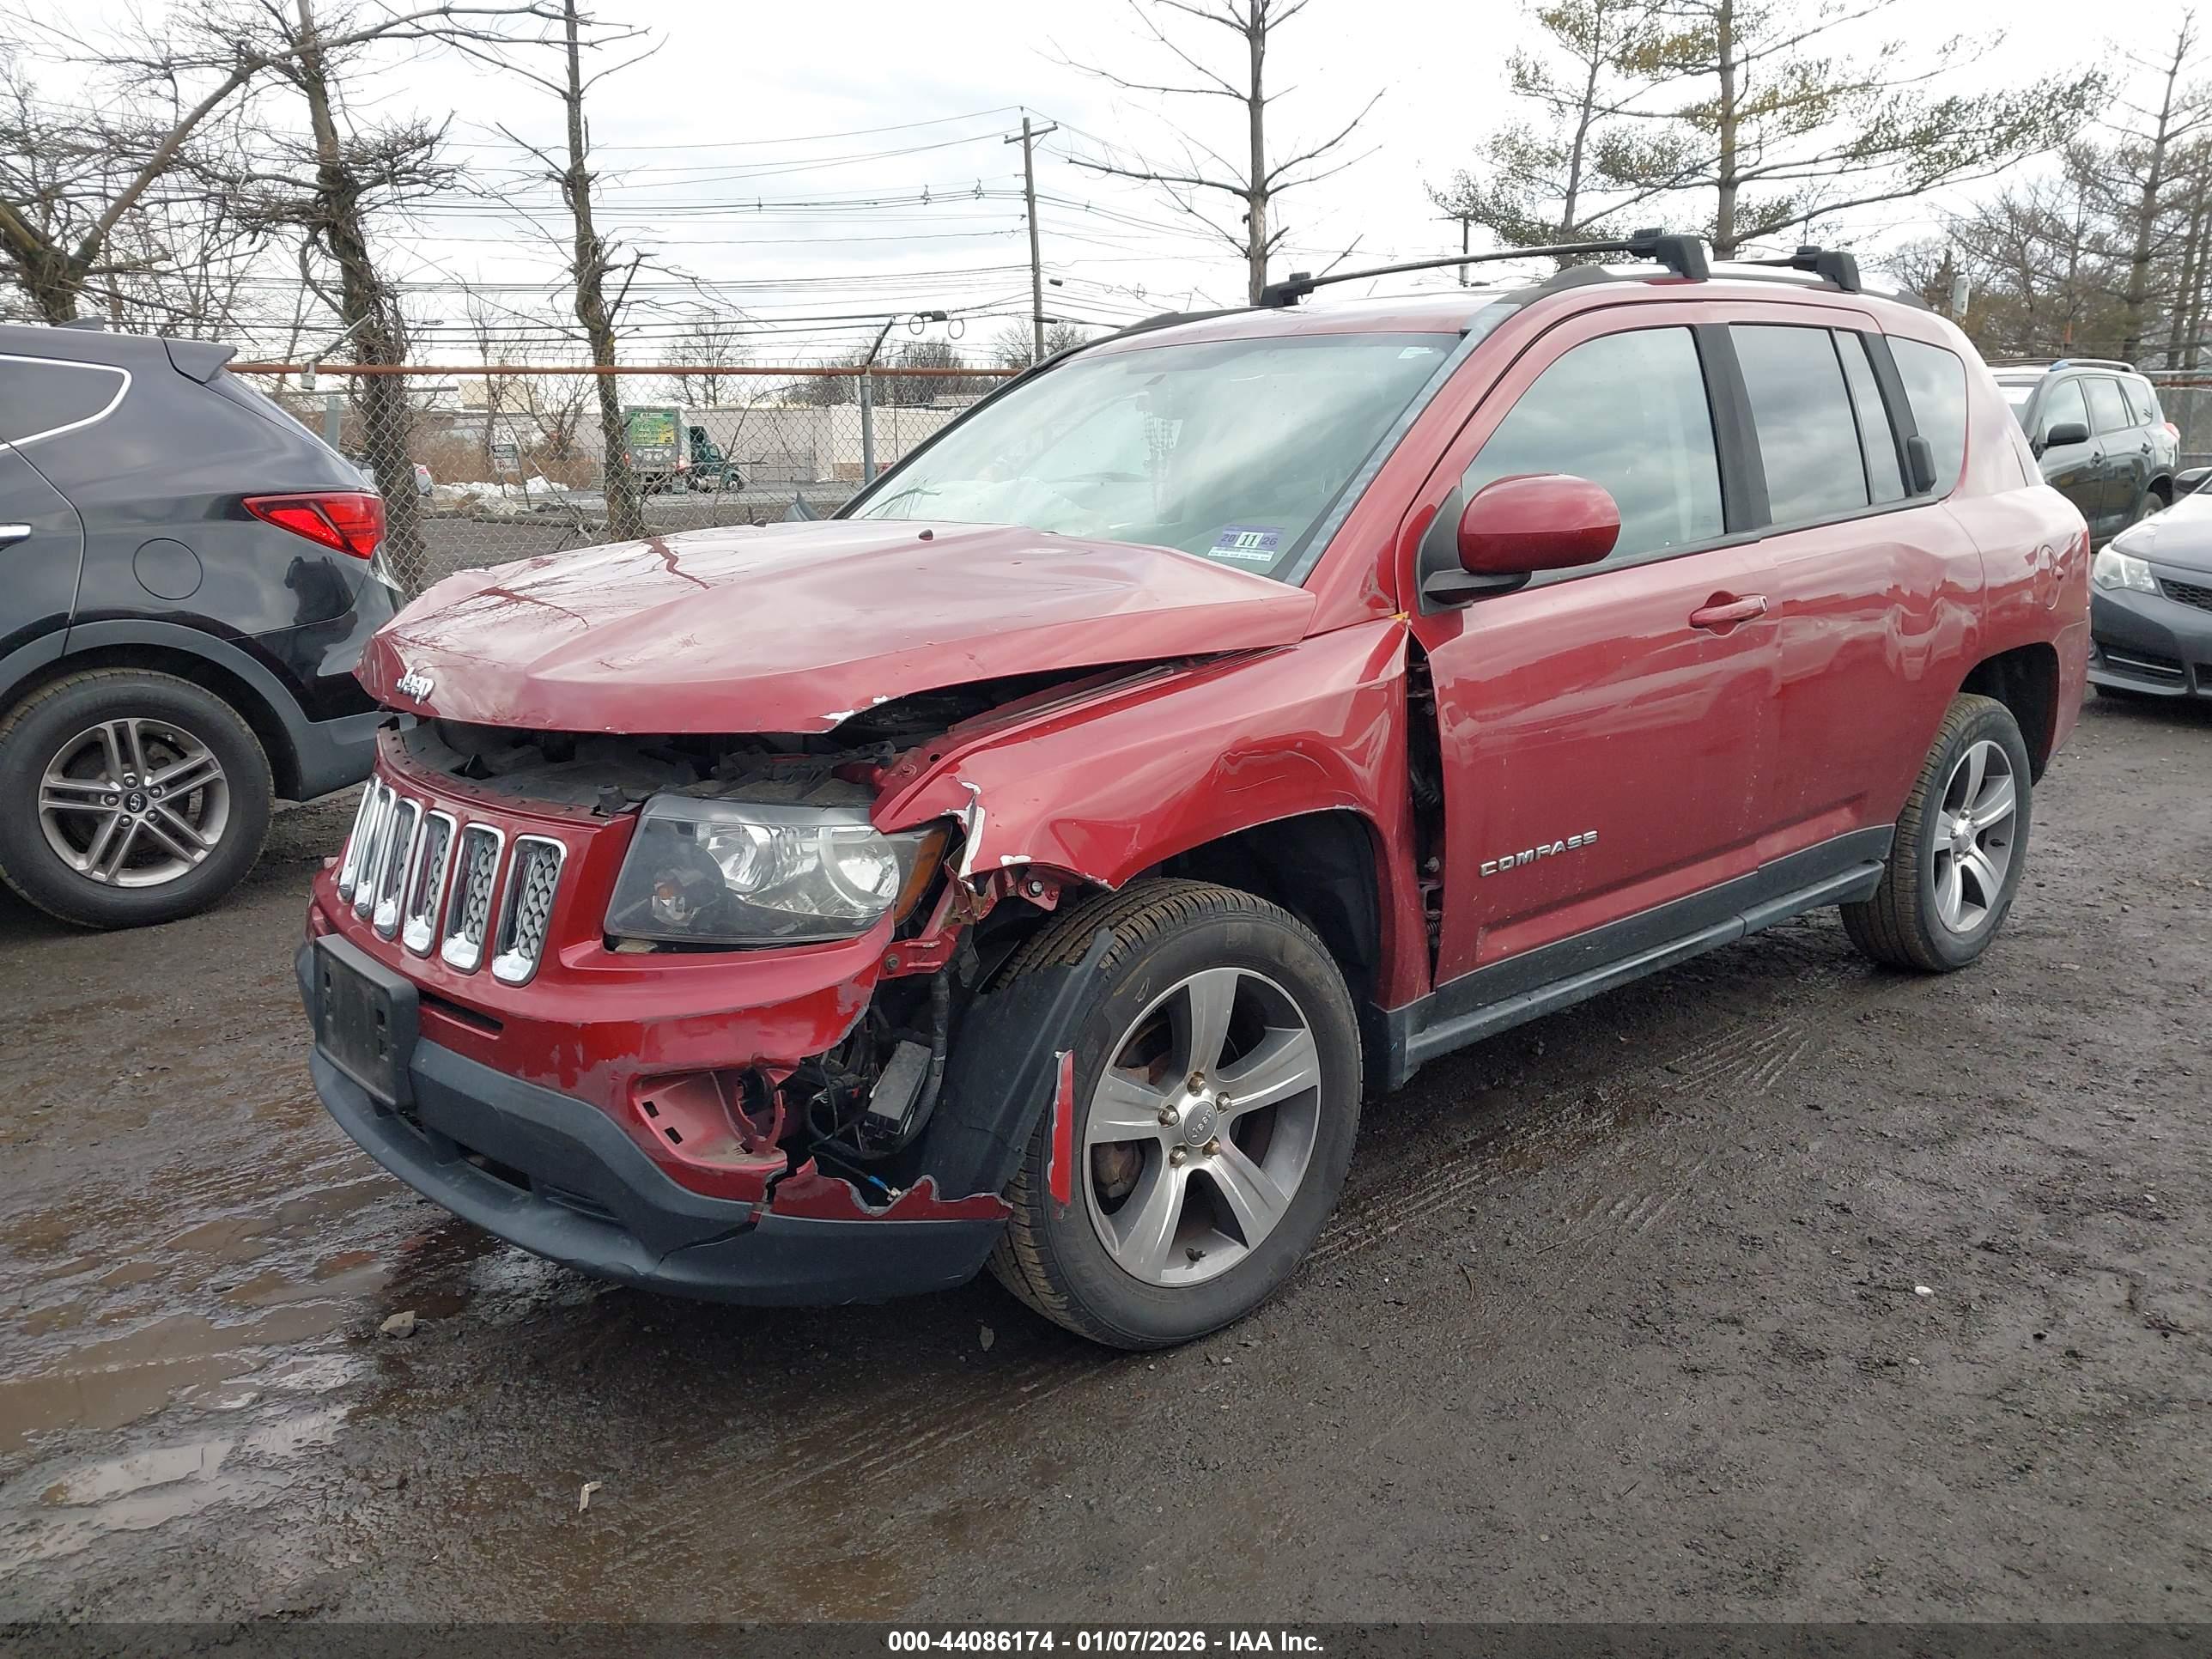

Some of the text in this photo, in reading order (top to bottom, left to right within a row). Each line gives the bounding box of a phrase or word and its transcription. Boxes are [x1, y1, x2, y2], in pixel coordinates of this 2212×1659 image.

[1221, 533, 1237, 543] 20
[1239, 533, 1258, 547] 11
[397, 666, 434, 705] Jeep
[1480, 830, 1599, 878] COMPASS
[1191, 1109, 1212, 1139] Jeep
